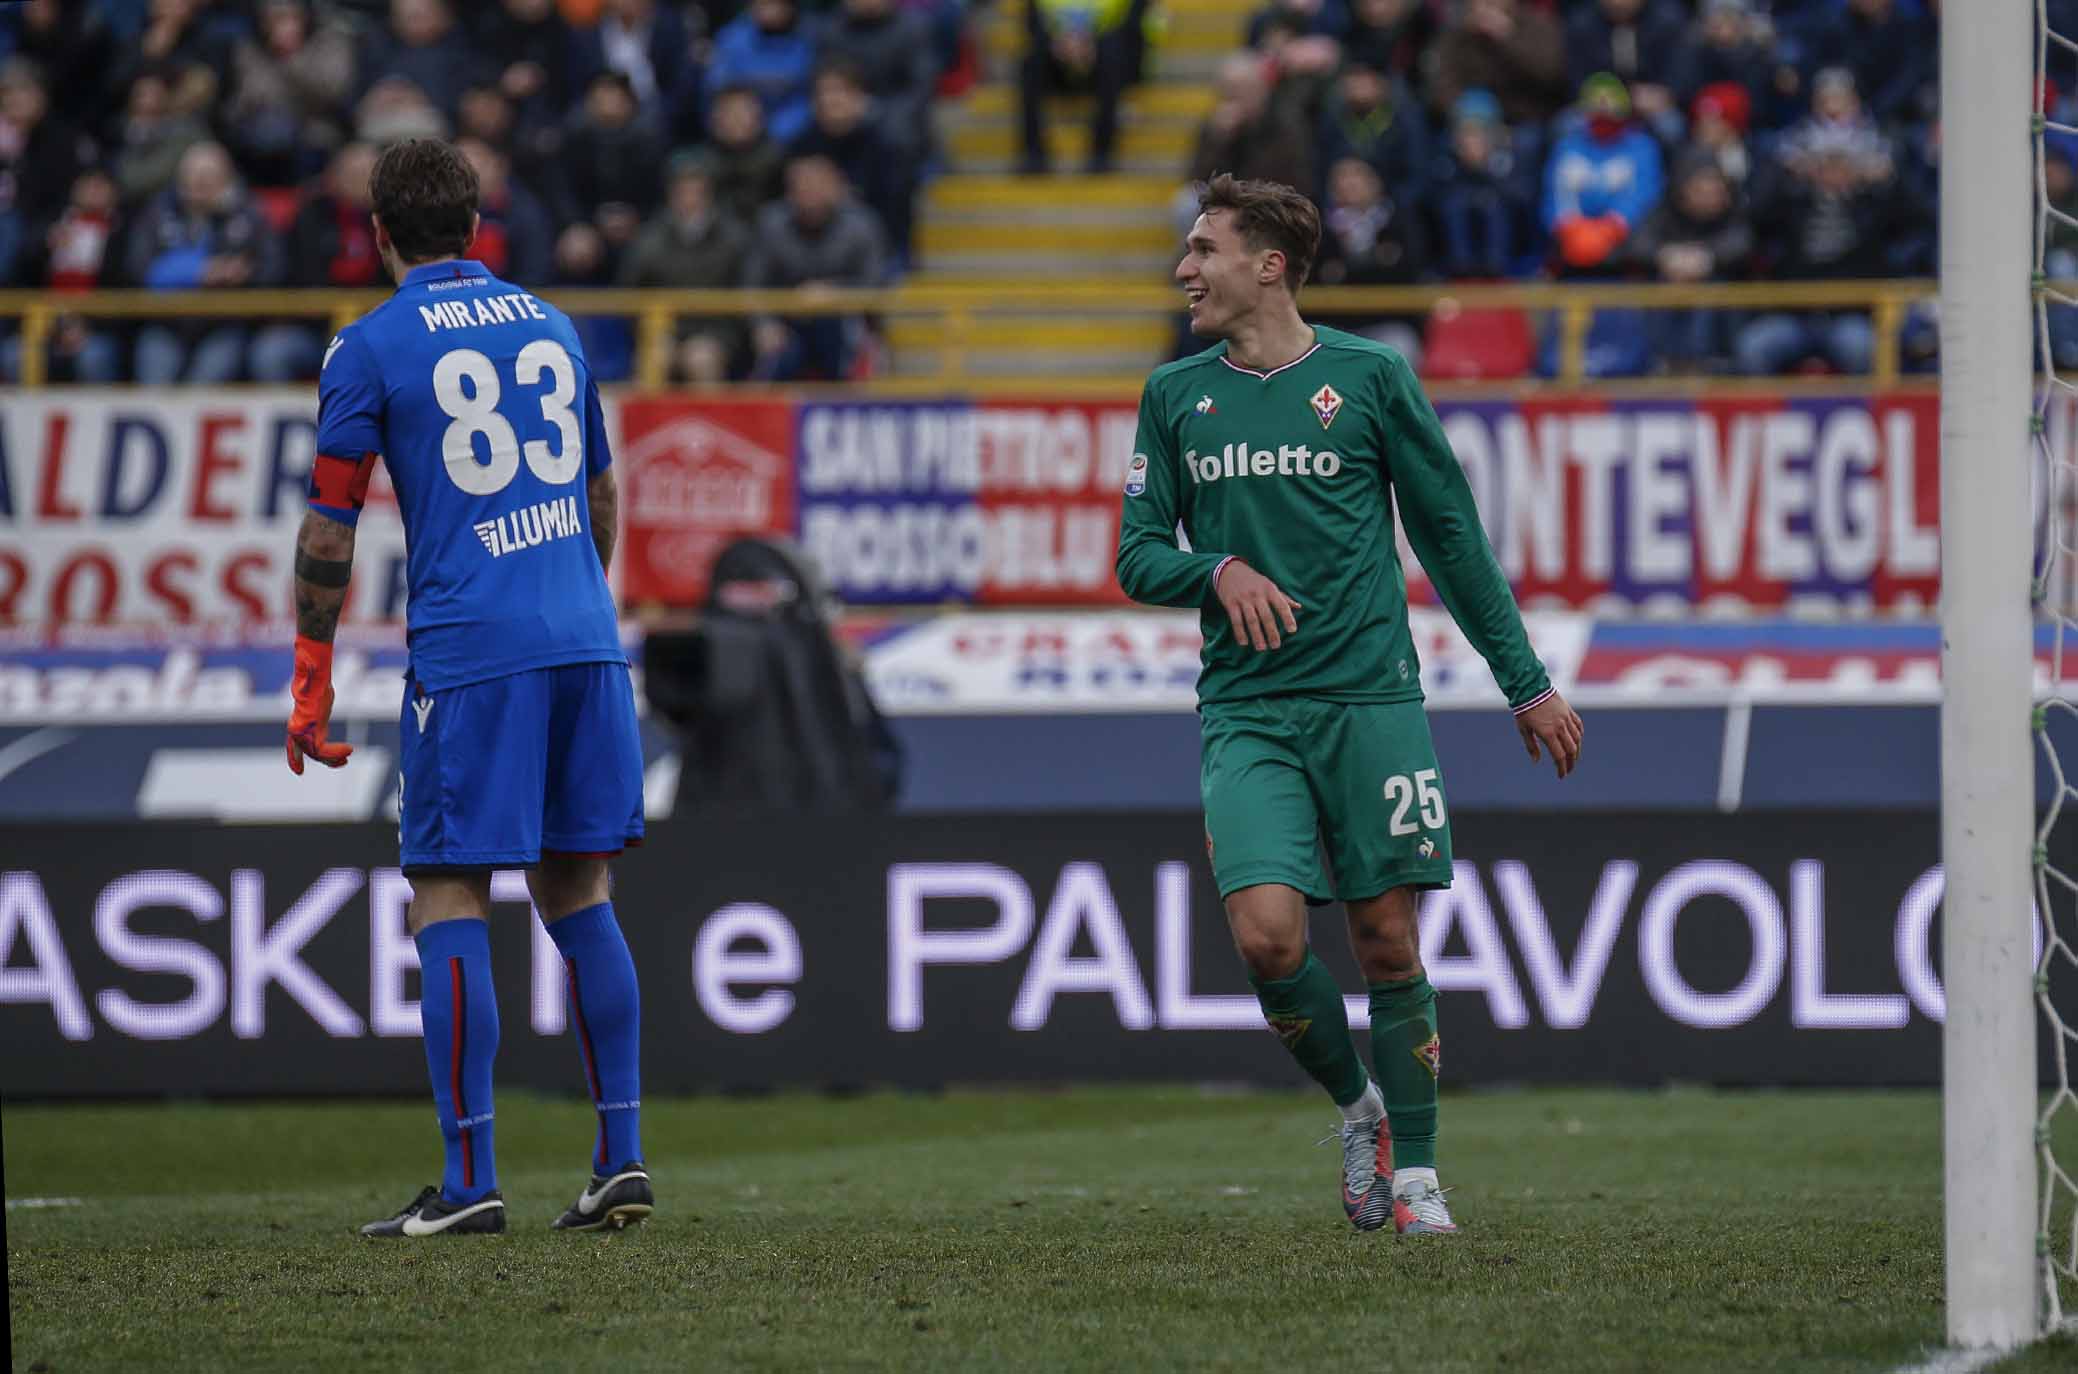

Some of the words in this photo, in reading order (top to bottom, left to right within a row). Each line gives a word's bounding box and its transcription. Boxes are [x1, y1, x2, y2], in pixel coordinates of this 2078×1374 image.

[419, 293, 547, 333] MIRANTE
[433, 339, 582, 496] 83
[1185, 442, 1342, 484] folletto
[0, 408, 318, 526] LDER
[1402, 409, 1940, 582] ONTEVEGL
[473, 496, 582, 558] ILLUMIA
[1383, 768, 1446, 837] 25
[692, 901, 802, 1034] e
[887, 859, 1948, 1032] PALAVOL
